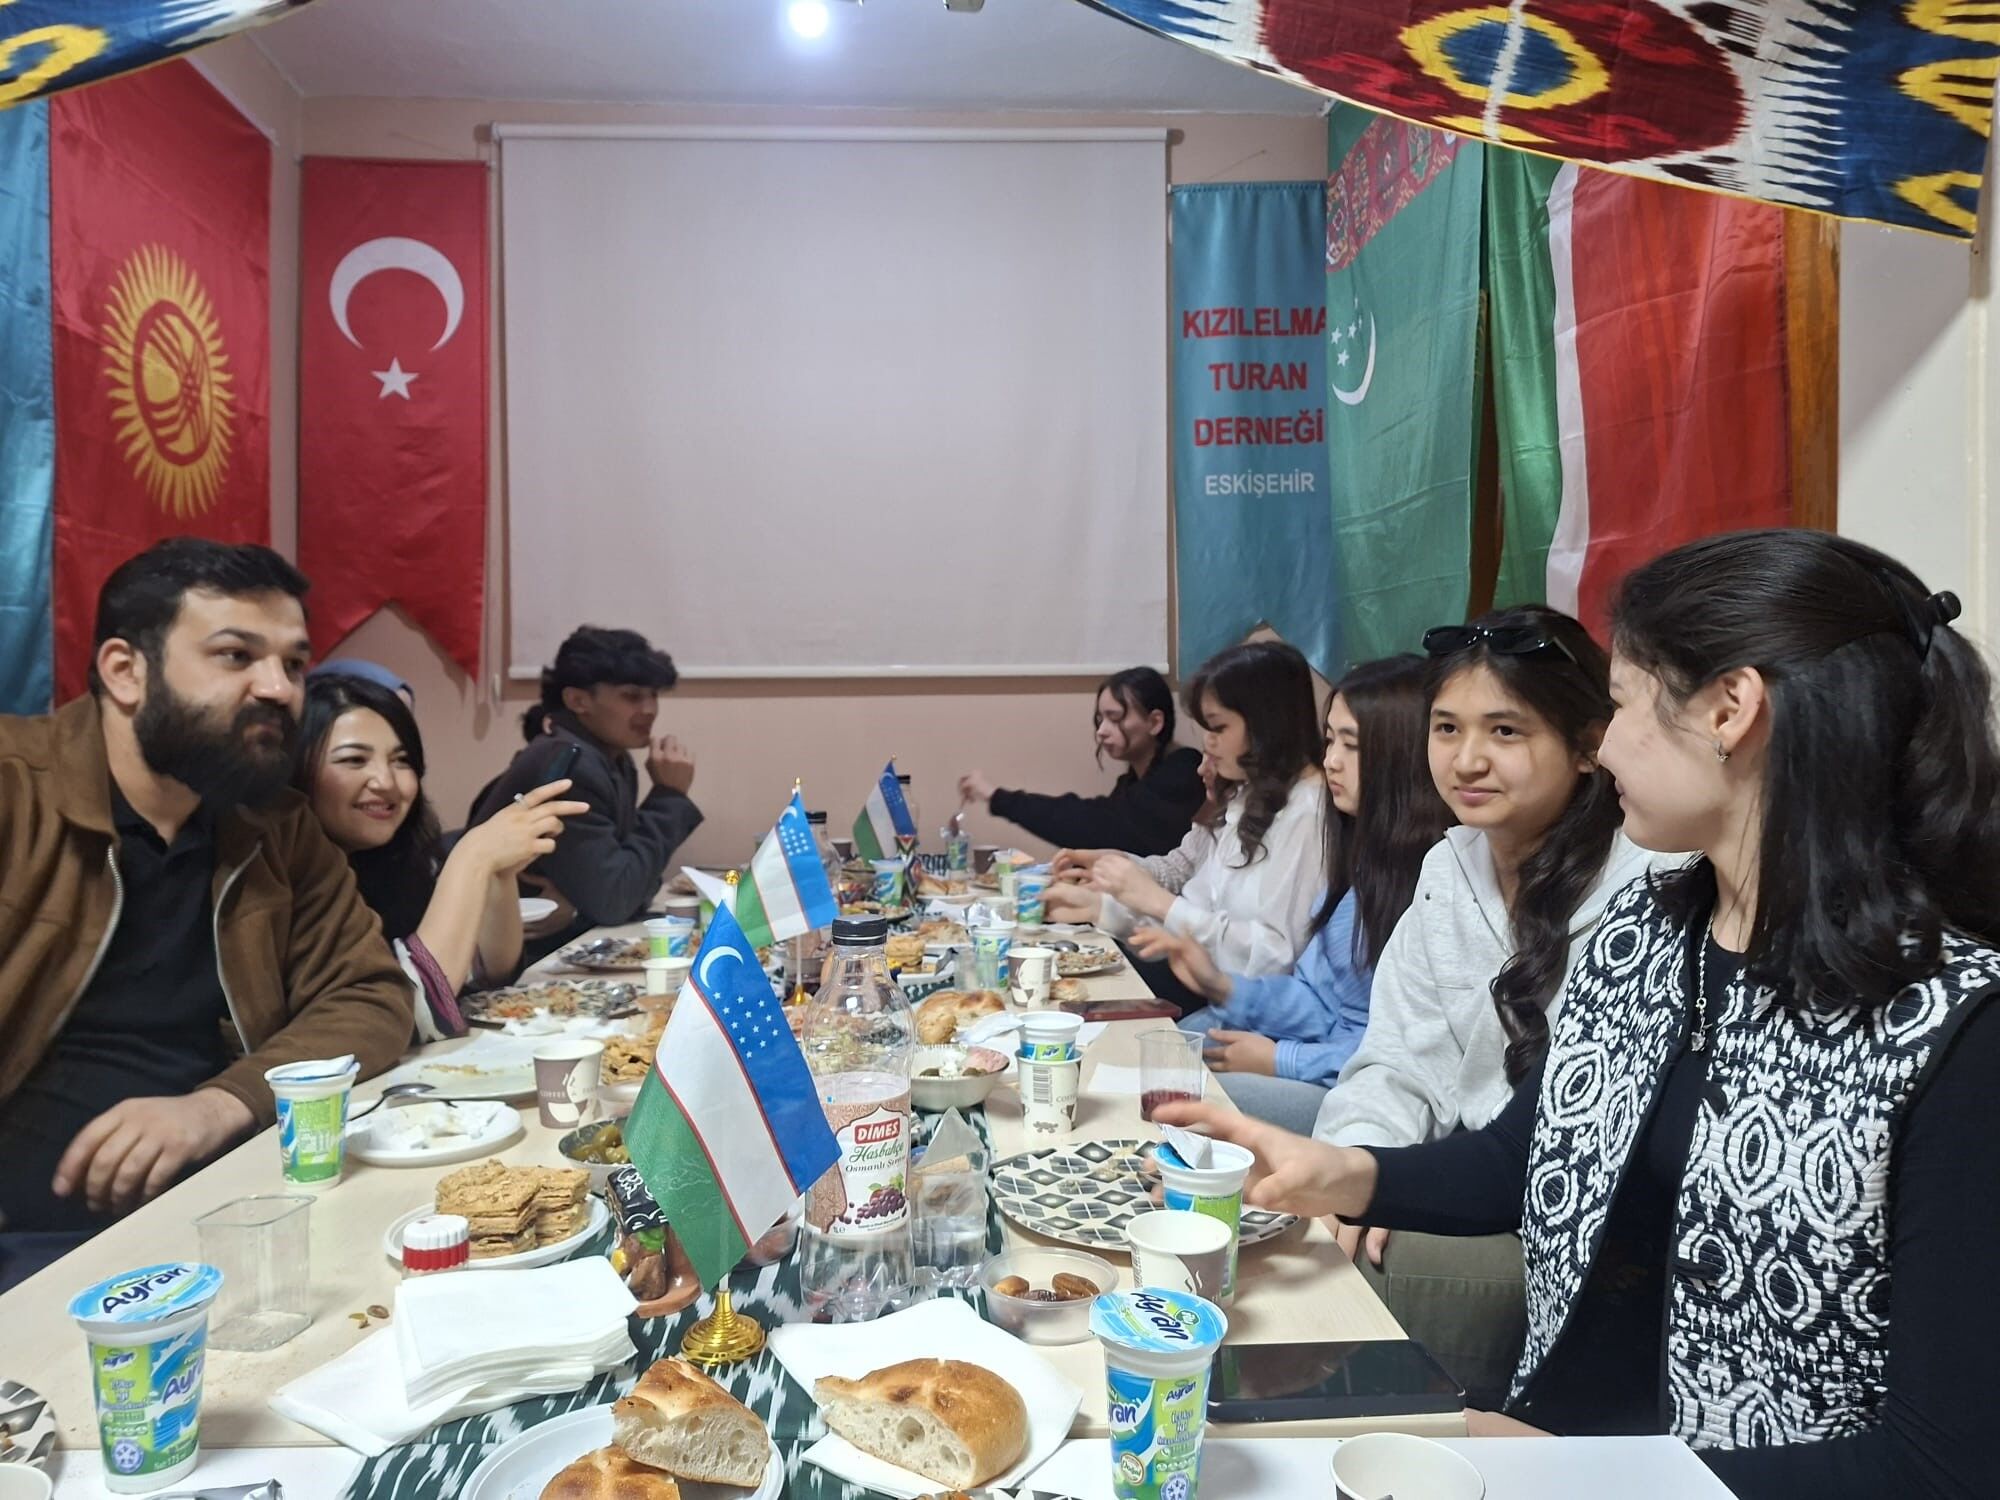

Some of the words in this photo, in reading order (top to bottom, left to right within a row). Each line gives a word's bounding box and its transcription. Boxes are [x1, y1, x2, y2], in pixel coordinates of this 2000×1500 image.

[1183, 306, 1326, 338] KIZILELMA
[1208, 362, 1307, 391] TURAN
[1194, 408, 1324, 446] DERNEĞİ
[1205, 469, 1315, 498] ESKİŞEHİR
[102, 1266, 191, 1314] Ayran
[1130, 1292, 1189, 1340] Ayran
[1166, 1381, 1197, 1402] Ayran
